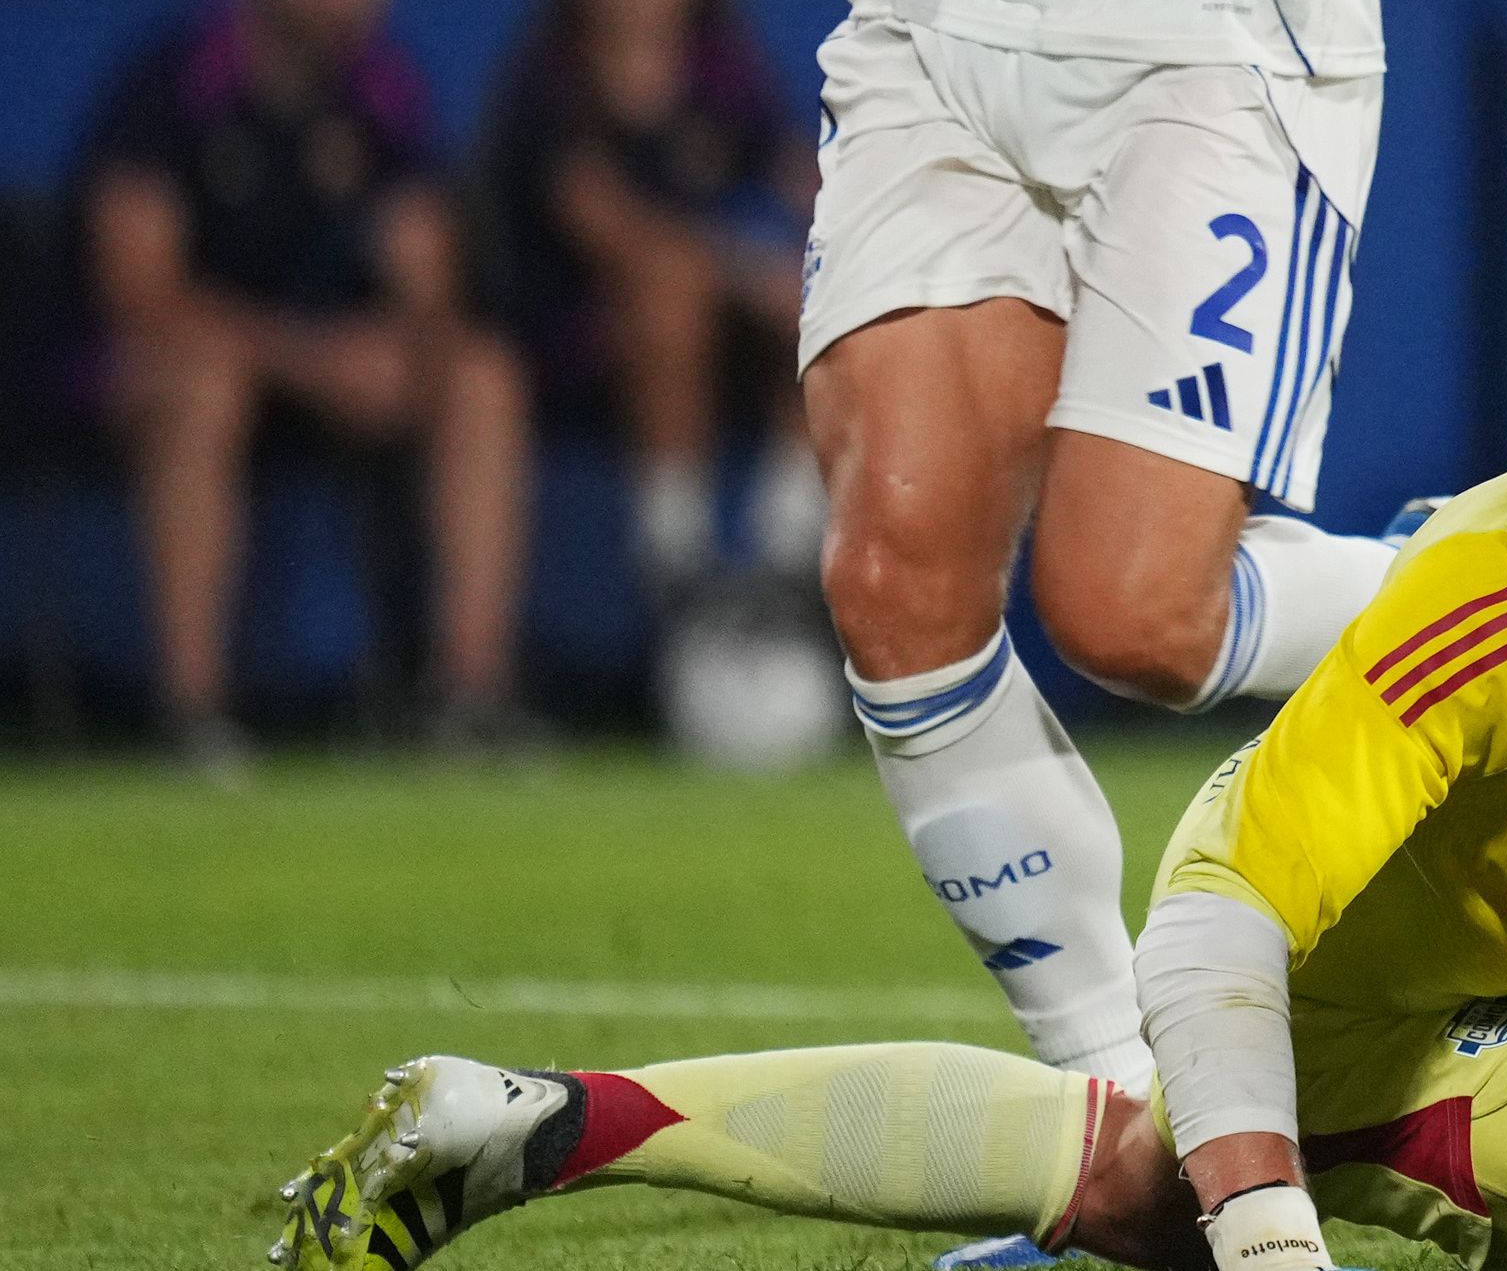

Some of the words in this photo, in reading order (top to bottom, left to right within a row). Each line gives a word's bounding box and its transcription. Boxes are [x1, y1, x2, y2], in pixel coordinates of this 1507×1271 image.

[1190, 213, 1268, 355] 2
[923, 850, 1053, 902] OMO
[1240, 1239, 1319, 1258] Charlotte
